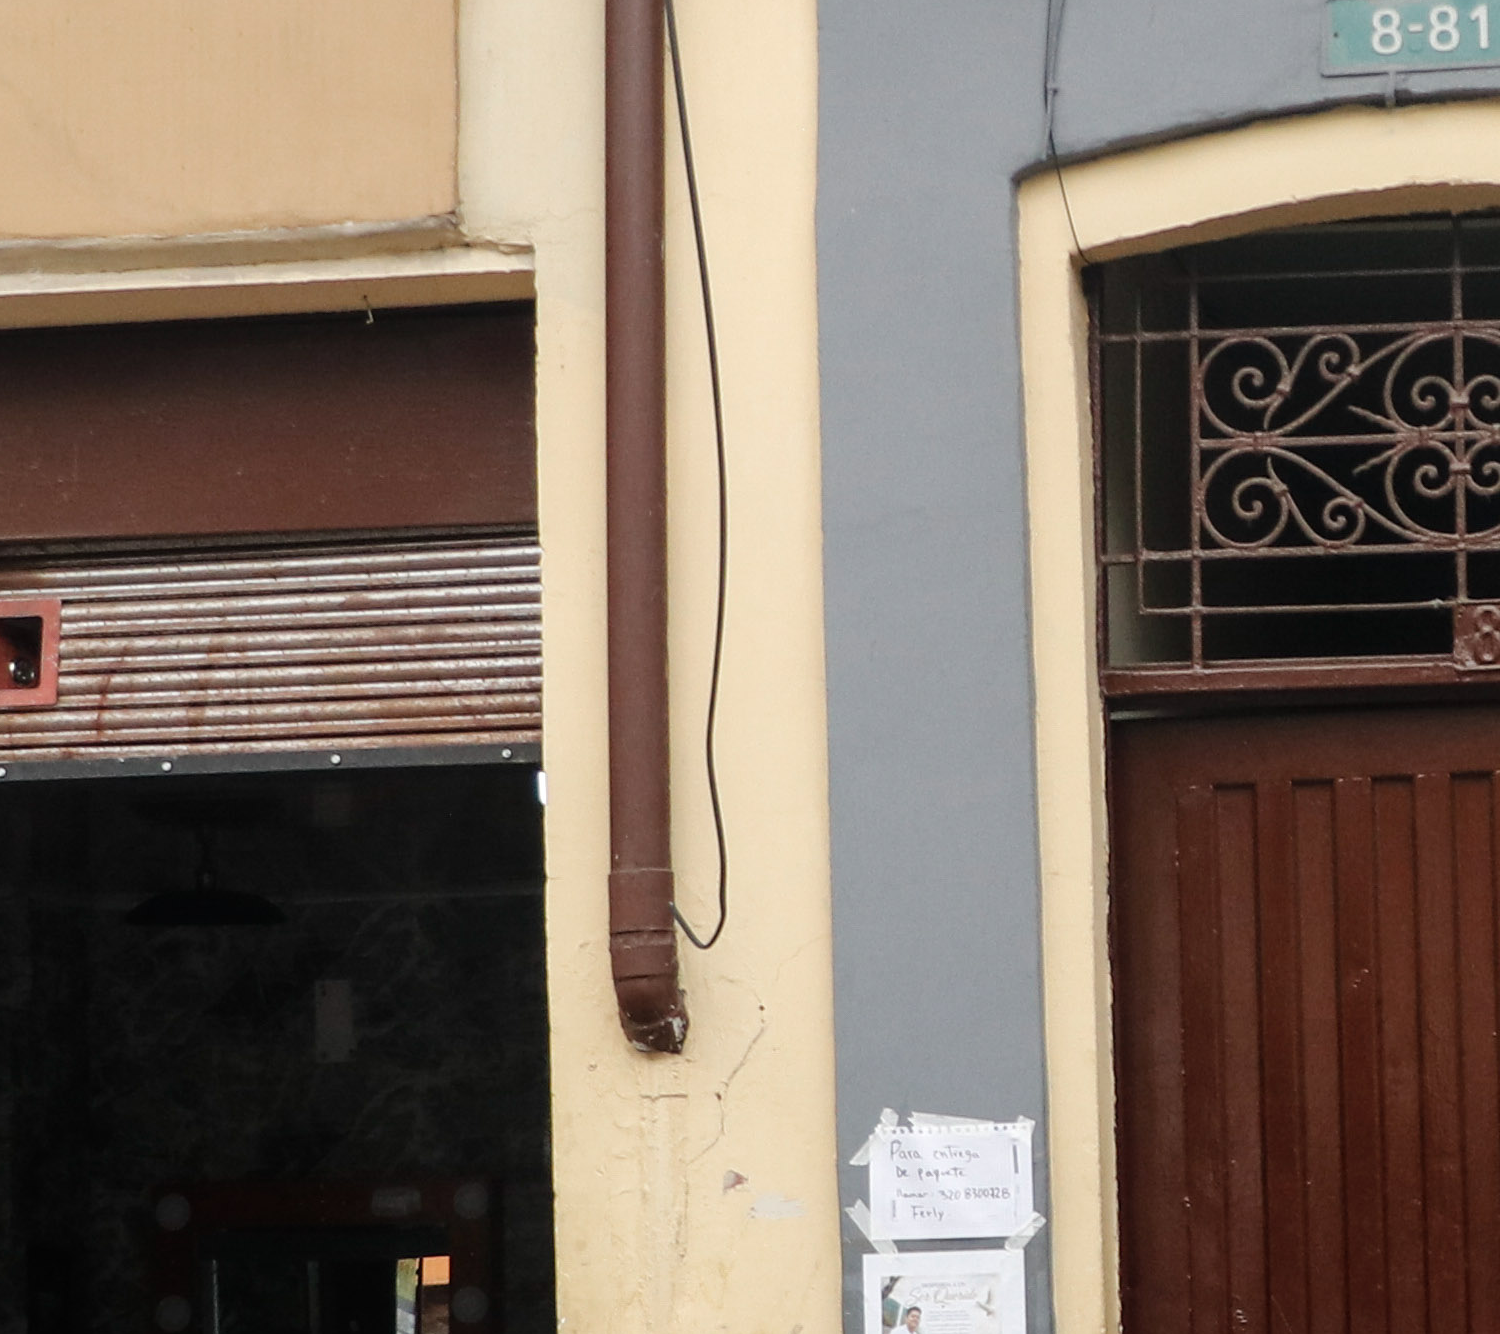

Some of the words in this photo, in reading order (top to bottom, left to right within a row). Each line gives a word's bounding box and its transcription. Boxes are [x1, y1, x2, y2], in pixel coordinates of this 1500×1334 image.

[1372, 4, 1490, 55] 8-81
[890, 1139, 922, 1161] Para
[933, 1145, 981, 1163] entrega
